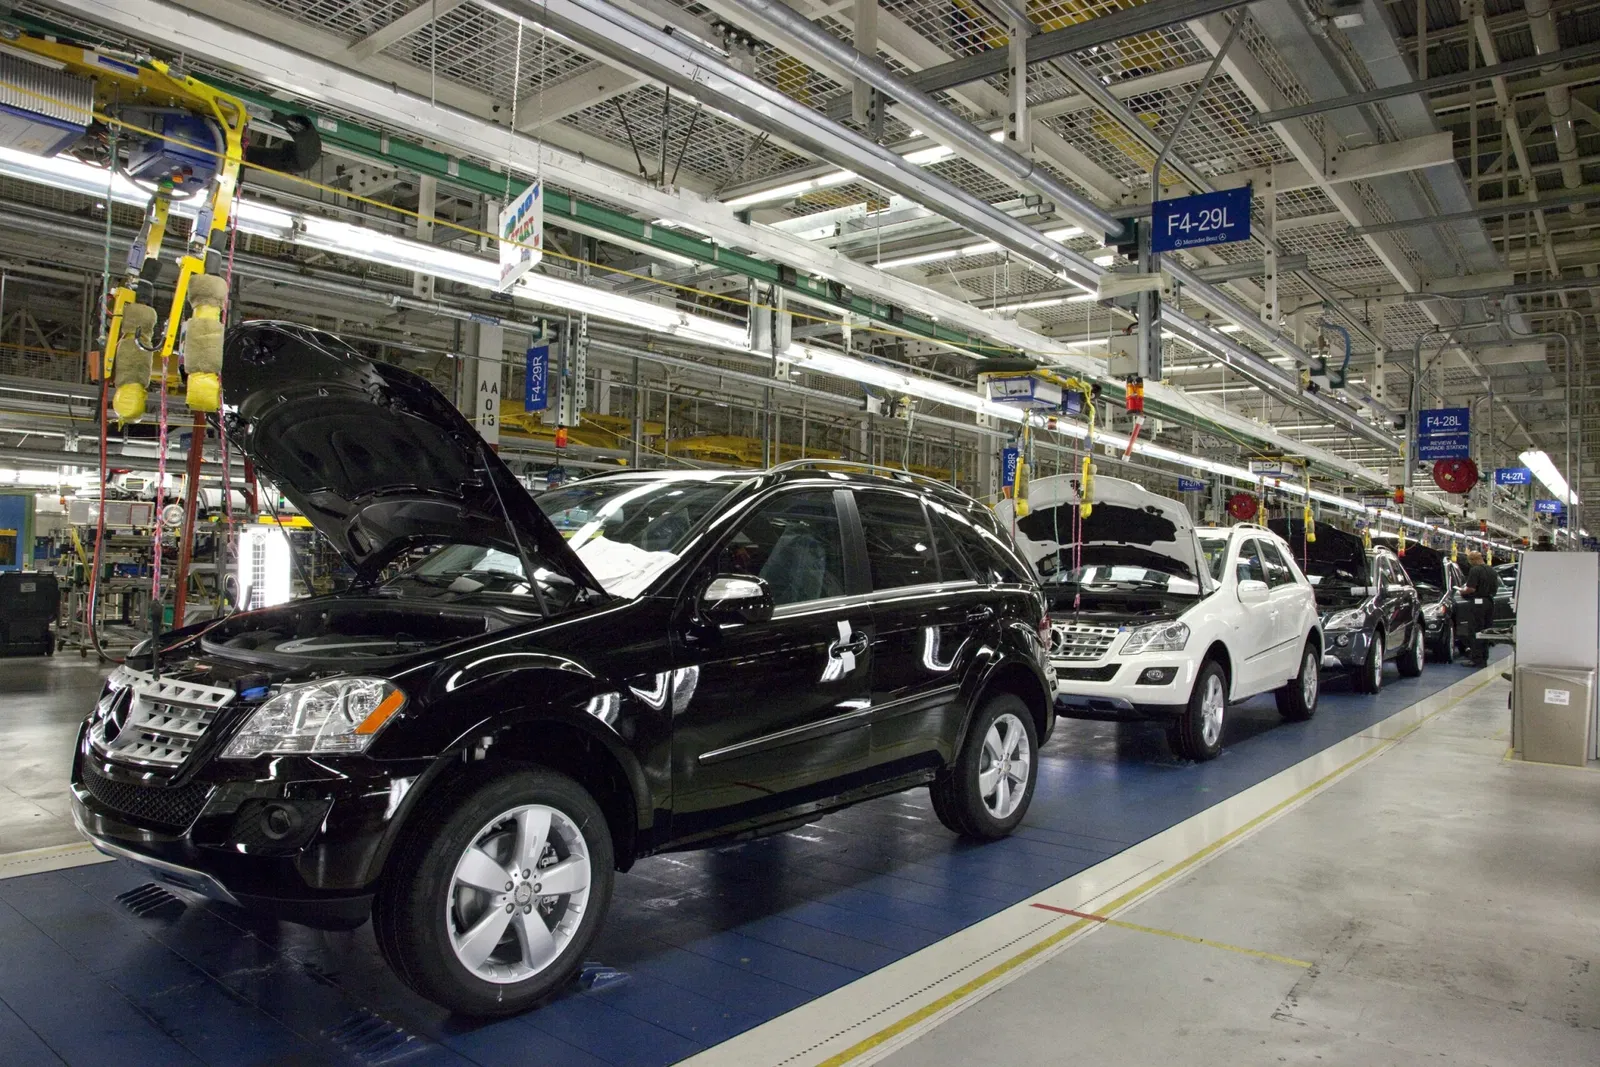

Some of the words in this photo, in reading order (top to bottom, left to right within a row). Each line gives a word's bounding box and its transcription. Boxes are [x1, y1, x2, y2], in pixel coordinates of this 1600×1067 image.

[518, 184, 540, 224] NOT
[1168, 207, 1234, 236] F4-29L
[532, 355, 543, 402] F4-29R
[1427, 416, 1462, 427] F4-28L
[1501, 472, 1525, 480] F4-27L
